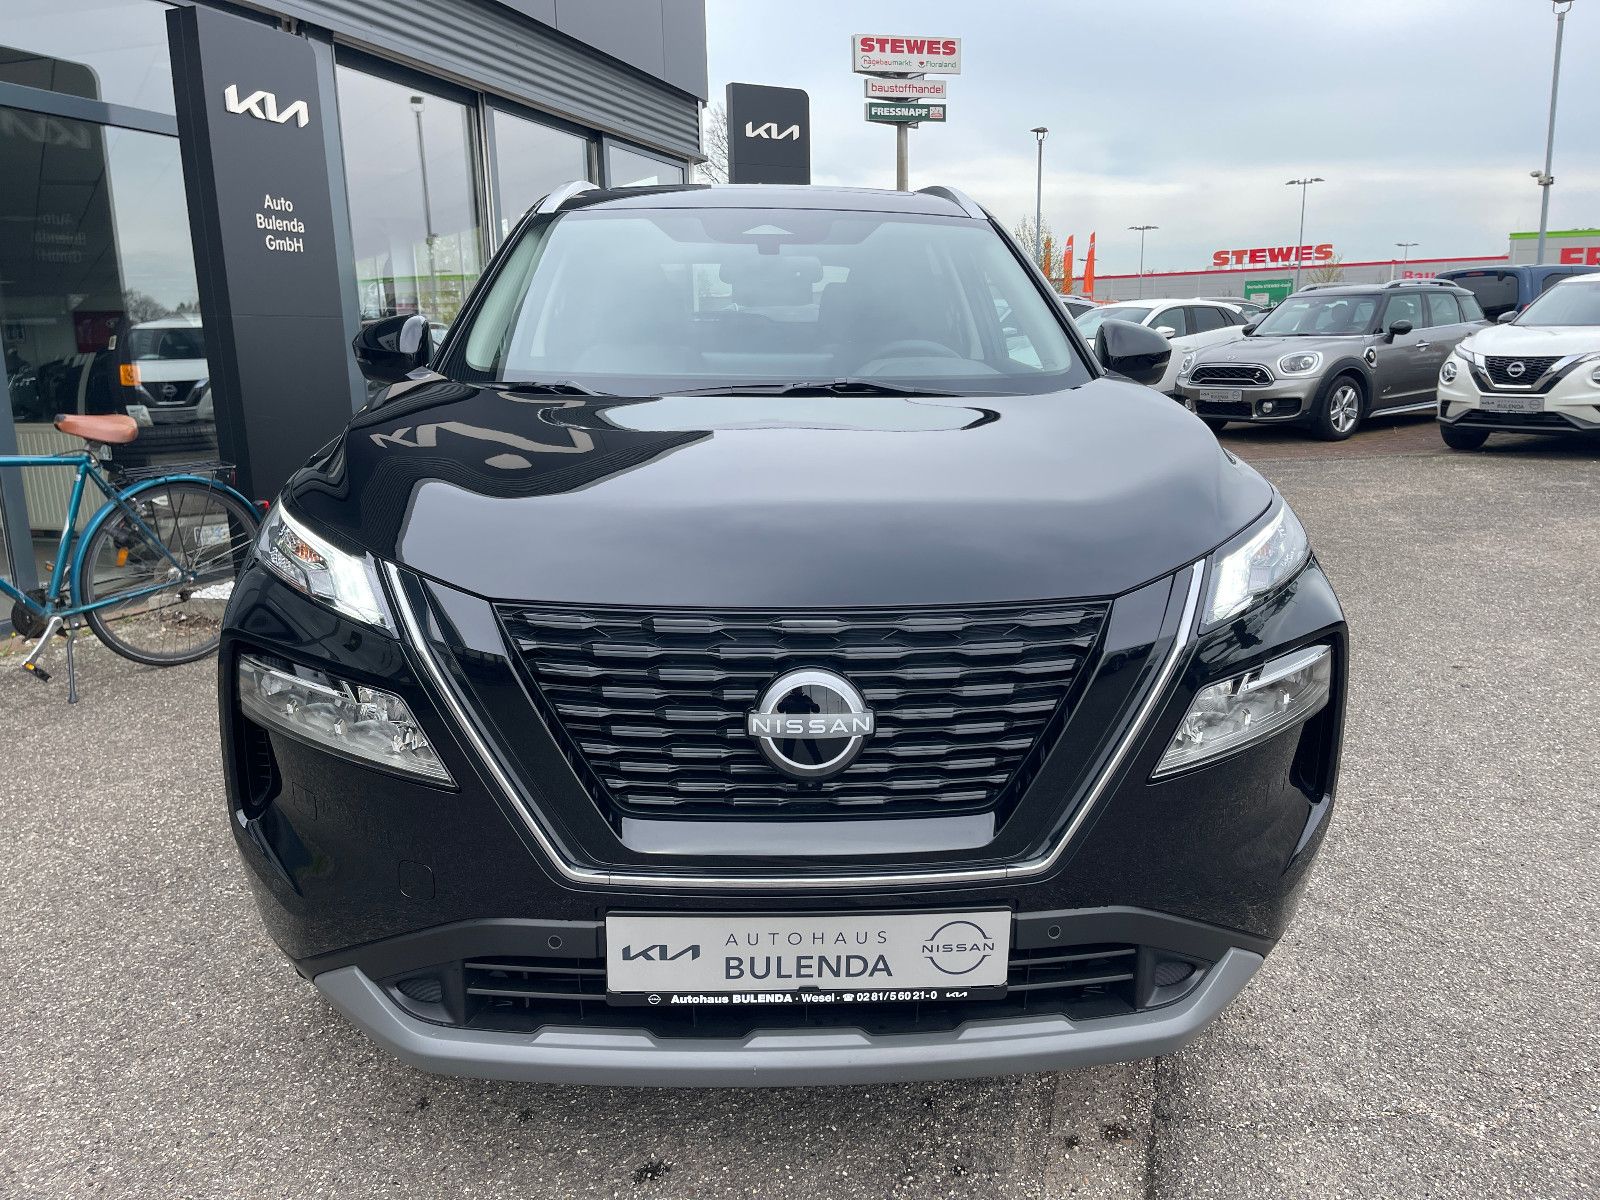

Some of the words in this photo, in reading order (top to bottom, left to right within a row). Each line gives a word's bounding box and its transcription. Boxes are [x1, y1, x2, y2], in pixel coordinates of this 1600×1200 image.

[860, 37, 957, 56] STEWES
[871, 82, 944, 94] baustoffhandel
[224, 84, 310, 128] KIA
[871, 106, 928, 117] FRESSNAPF
[745, 121, 800, 141] KIA
[263, 194, 294, 212] Auto
[256, 213, 305, 234] Bulenda
[265, 234, 304, 253] GmbH
[1212, 244, 1334, 267] STEWES
[752, 716, 870, 735] NISSAN
[725, 930, 887, 946] AUTOHAUS
[621, 944, 701, 961] KIA
[922, 942, 995, 954] NISSAN
[725, 954, 893, 980] BULENDA
[671, 994, 730, 1004] Autohaus
[732, 993, 793, 1004] BULENDA
[801, 992, 836, 1003] Wesel
